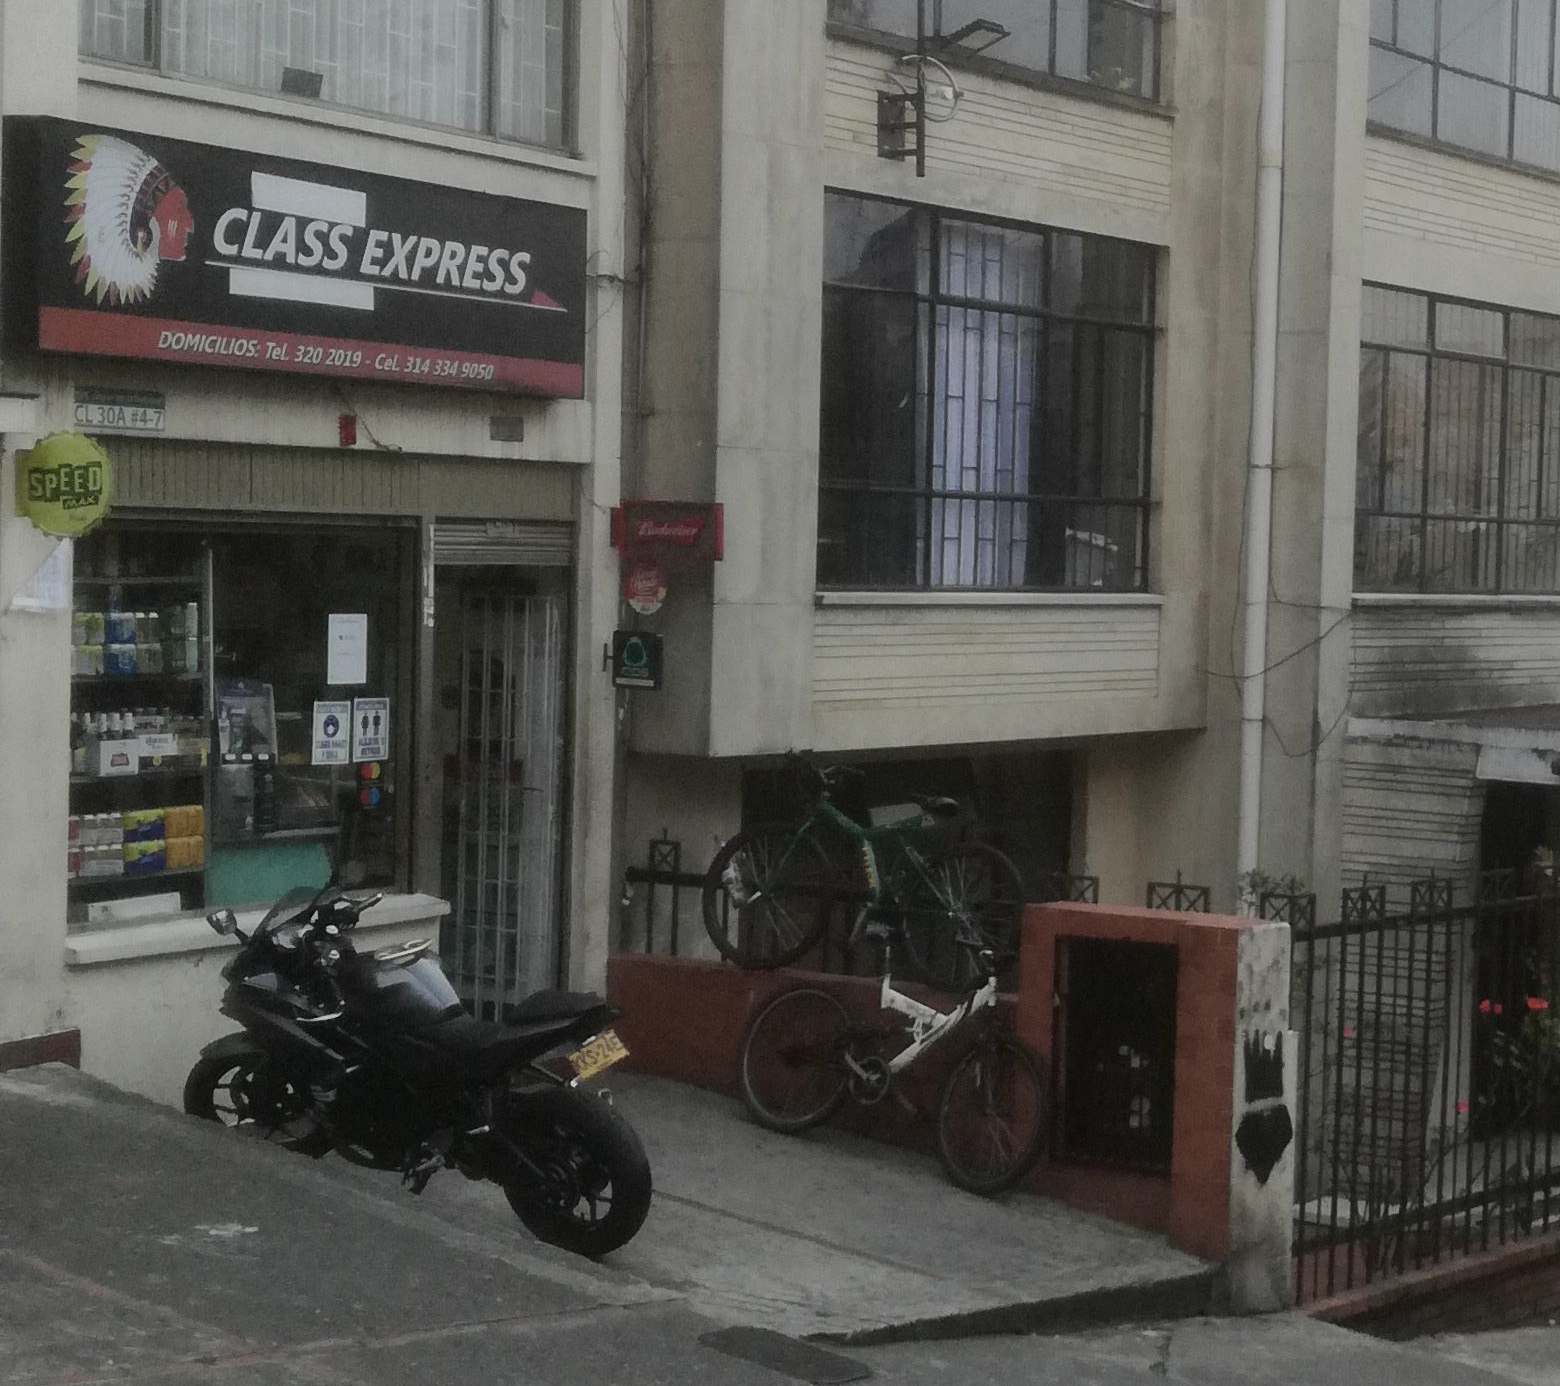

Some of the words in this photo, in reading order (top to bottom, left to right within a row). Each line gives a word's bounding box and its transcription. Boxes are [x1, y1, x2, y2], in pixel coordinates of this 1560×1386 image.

[213, 207, 354, 270] CLASS
[359, 228, 531, 295] EXPRESS
[157, 330, 260, 358] DOMICILIOS:
[293, 345, 323, 365] 320
[325, 348, 363, 368] 2019
[403, 356, 430, 375] 314
[432, 359, 459, 378] 334
[461, 362, 496, 381] 9050
[74, 405, 93, 424] CL
[97, 405, 126, 427] 30A
[30, 466, 102, 500] SPEED
